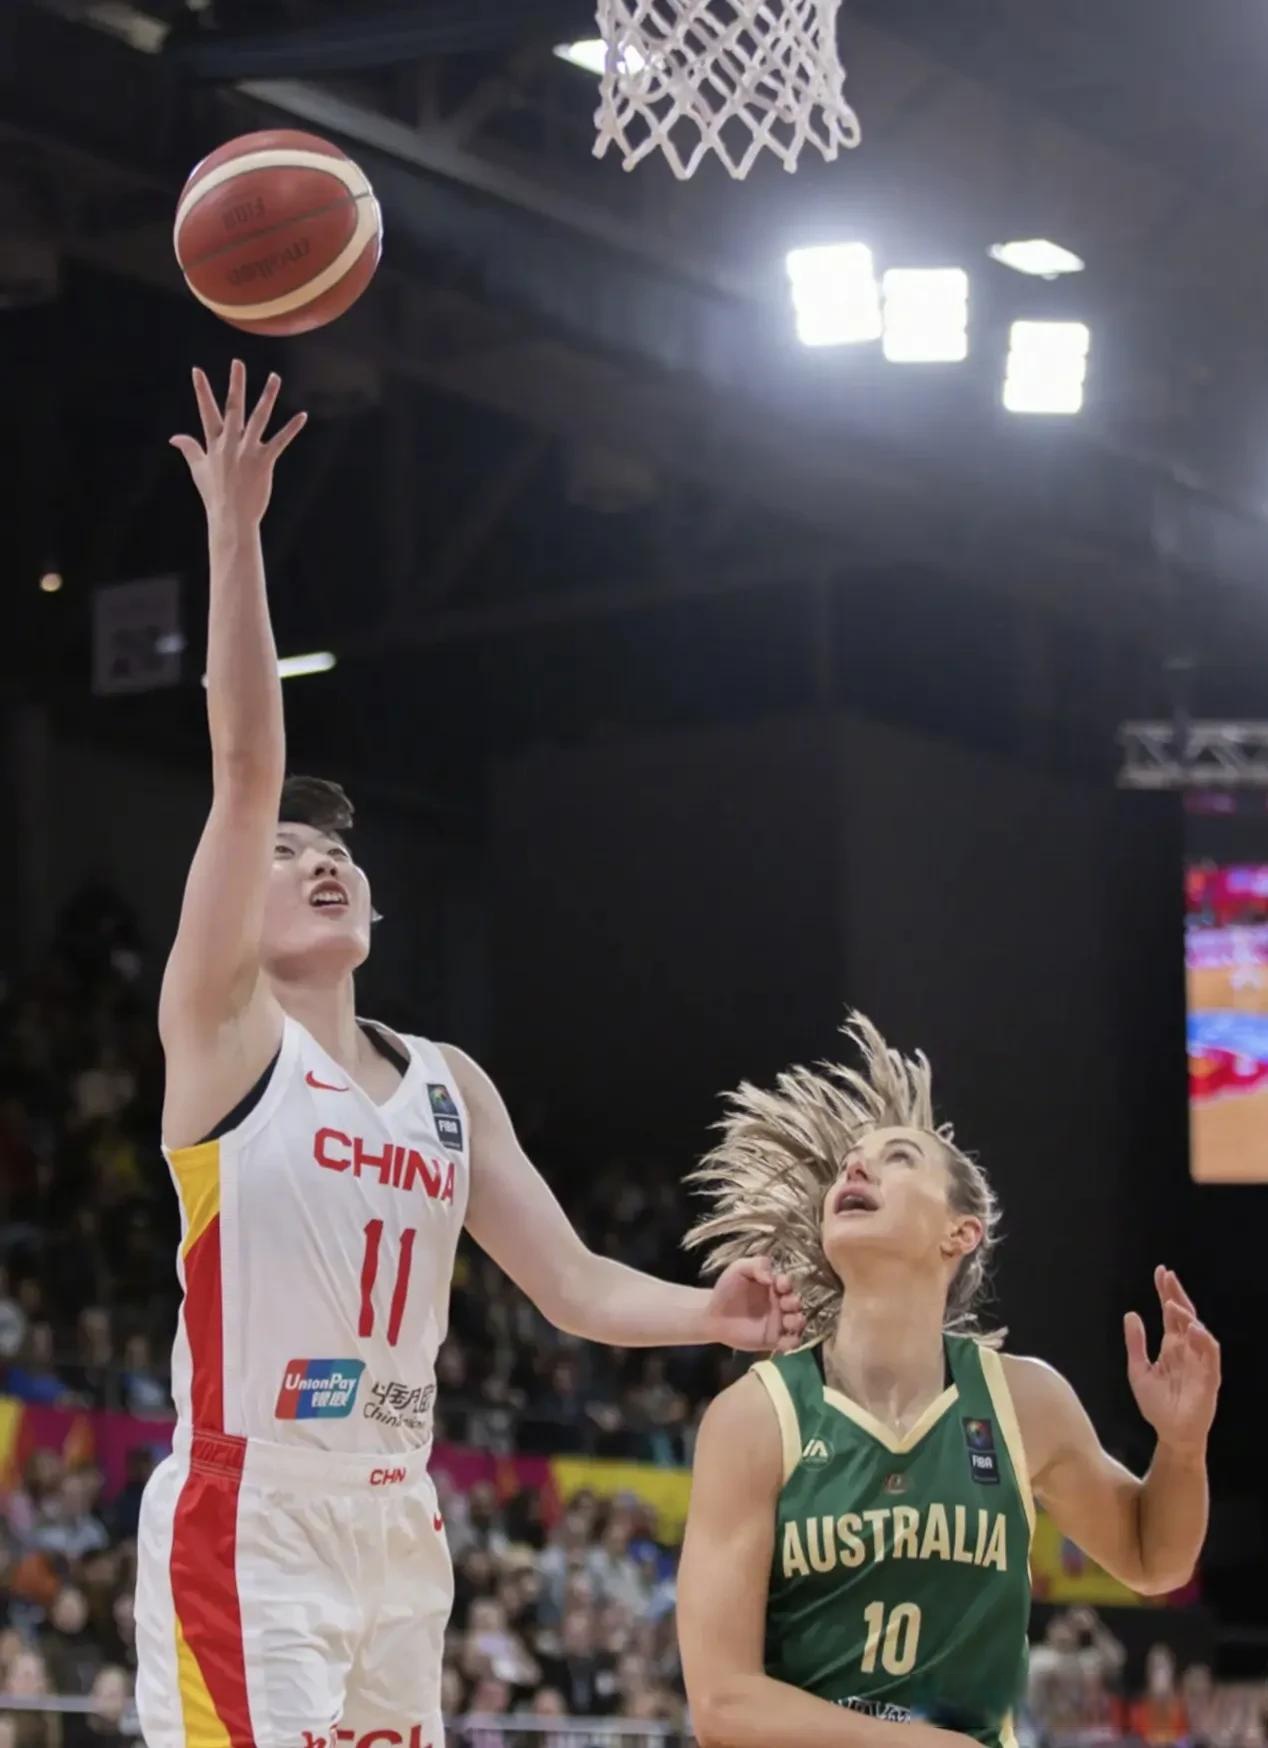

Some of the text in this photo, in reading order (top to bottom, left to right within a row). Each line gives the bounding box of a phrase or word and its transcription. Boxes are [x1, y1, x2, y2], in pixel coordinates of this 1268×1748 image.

[313, 1126, 455, 1207] CHINA
[357, 1218, 417, 1347] 11
[284, 1372, 358, 1396] UnionPay
[369, 1466, 407, 1486] CHN
[971, 1453, 994, 1469] FIBA
[782, 1502, 1008, 1579] AUSTRALIA
[860, 1600, 922, 1677] 10
